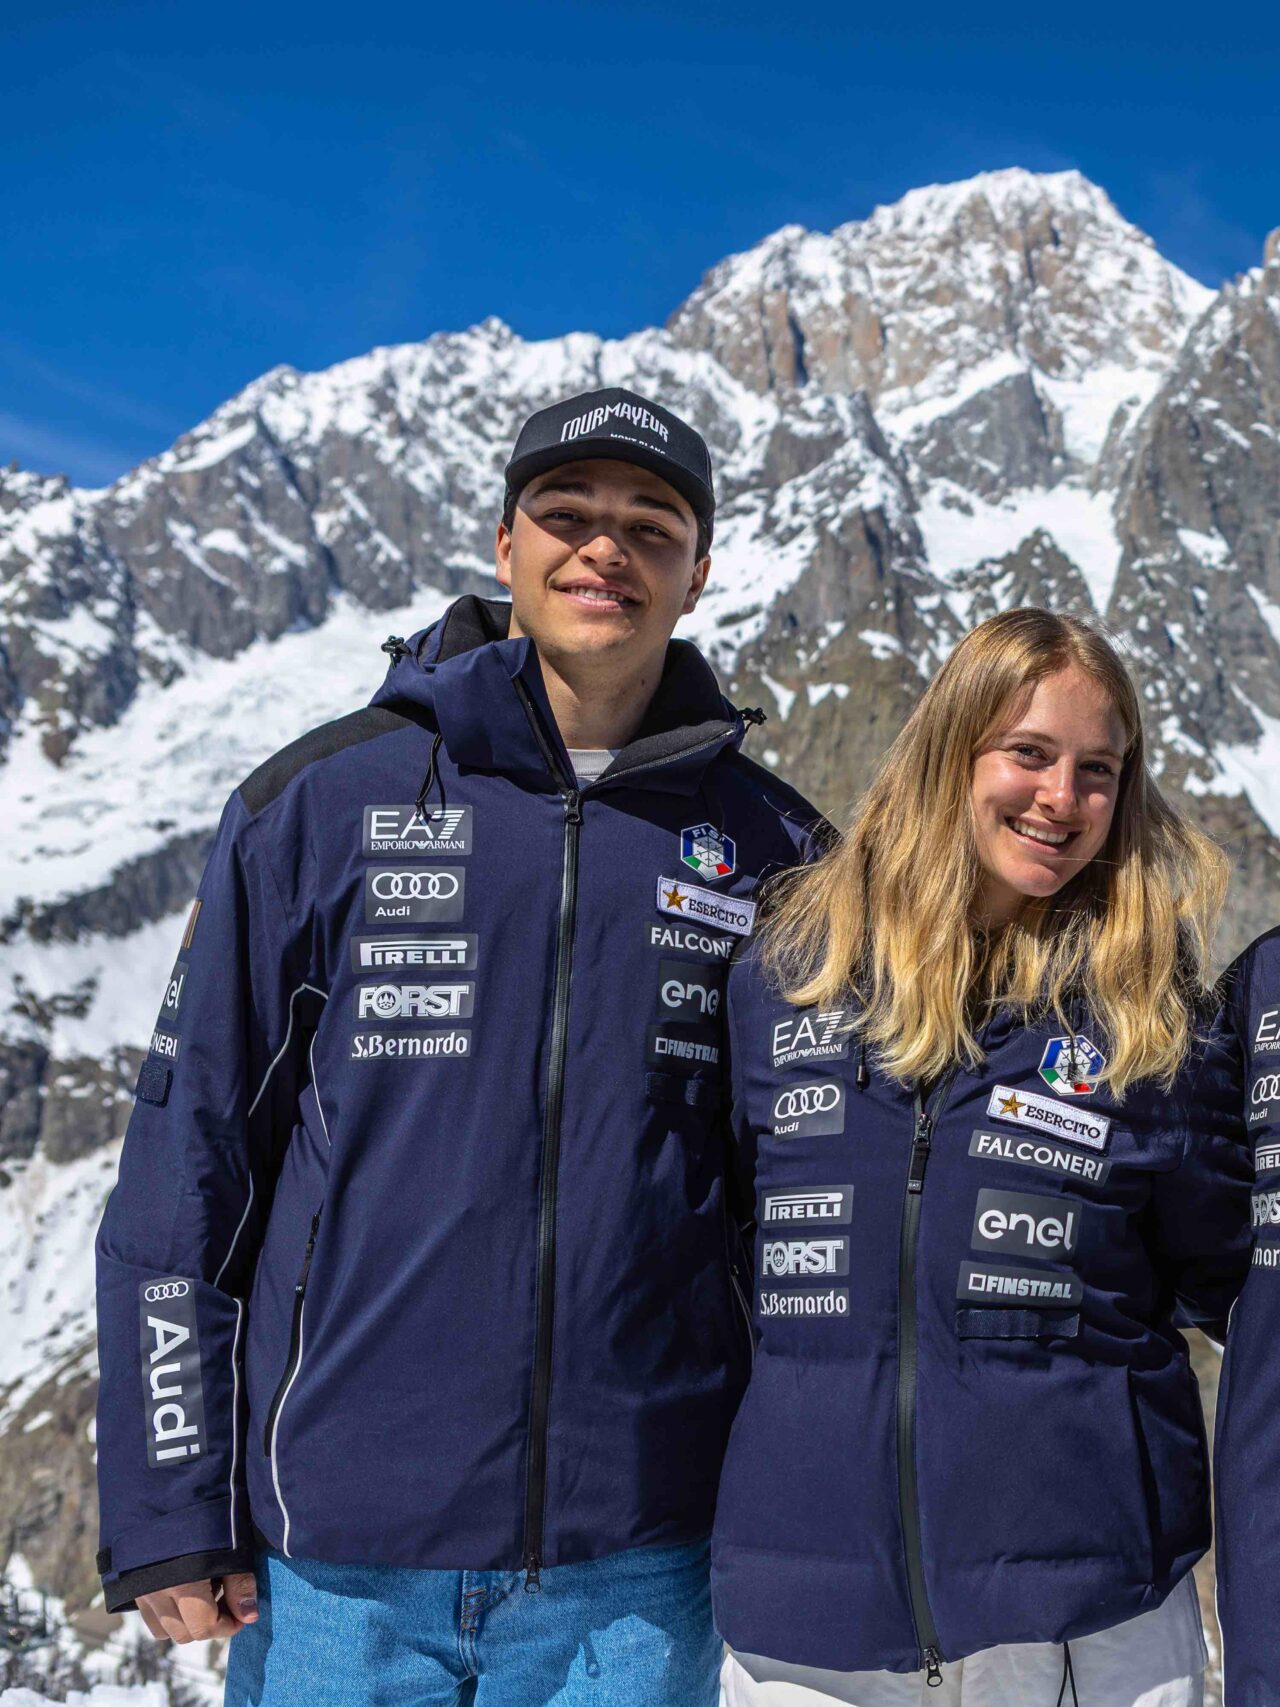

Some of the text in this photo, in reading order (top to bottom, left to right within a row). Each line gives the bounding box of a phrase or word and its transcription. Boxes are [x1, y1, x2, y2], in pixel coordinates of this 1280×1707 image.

[560, 402, 669, 443] COURMAYEUR
[371, 810, 465, 839] EA7
[371, 840, 465, 850] EMPORIO ARMANI
[374, 906, 411, 917] Audi
[688, 898, 748, 927] ESERCITO
[360, 940, 469, 967] PIRELLI
[358, 985, 470, 1019] FORST
[351, 1032, 468, 1058] S.Bernardo
[773, 1011, 845, 1056] EA7
[774, 1121, 800, 1136] Audi
[1024, 1106, 1101, 1140] ESERCITO
[1249, 1108, 1268, 1123] Audi
[977, 1134, 1104, 1182] FALCONERI
[764, 1192, 844, 1221] PIRELLI
[978, 1209, 1075, 1250] enel
[762, 1240, 844, 1276] FORST
[986, 1274, 1072, 1299] FINSTRAL
[146, 1314, 199, 1462] Audi
